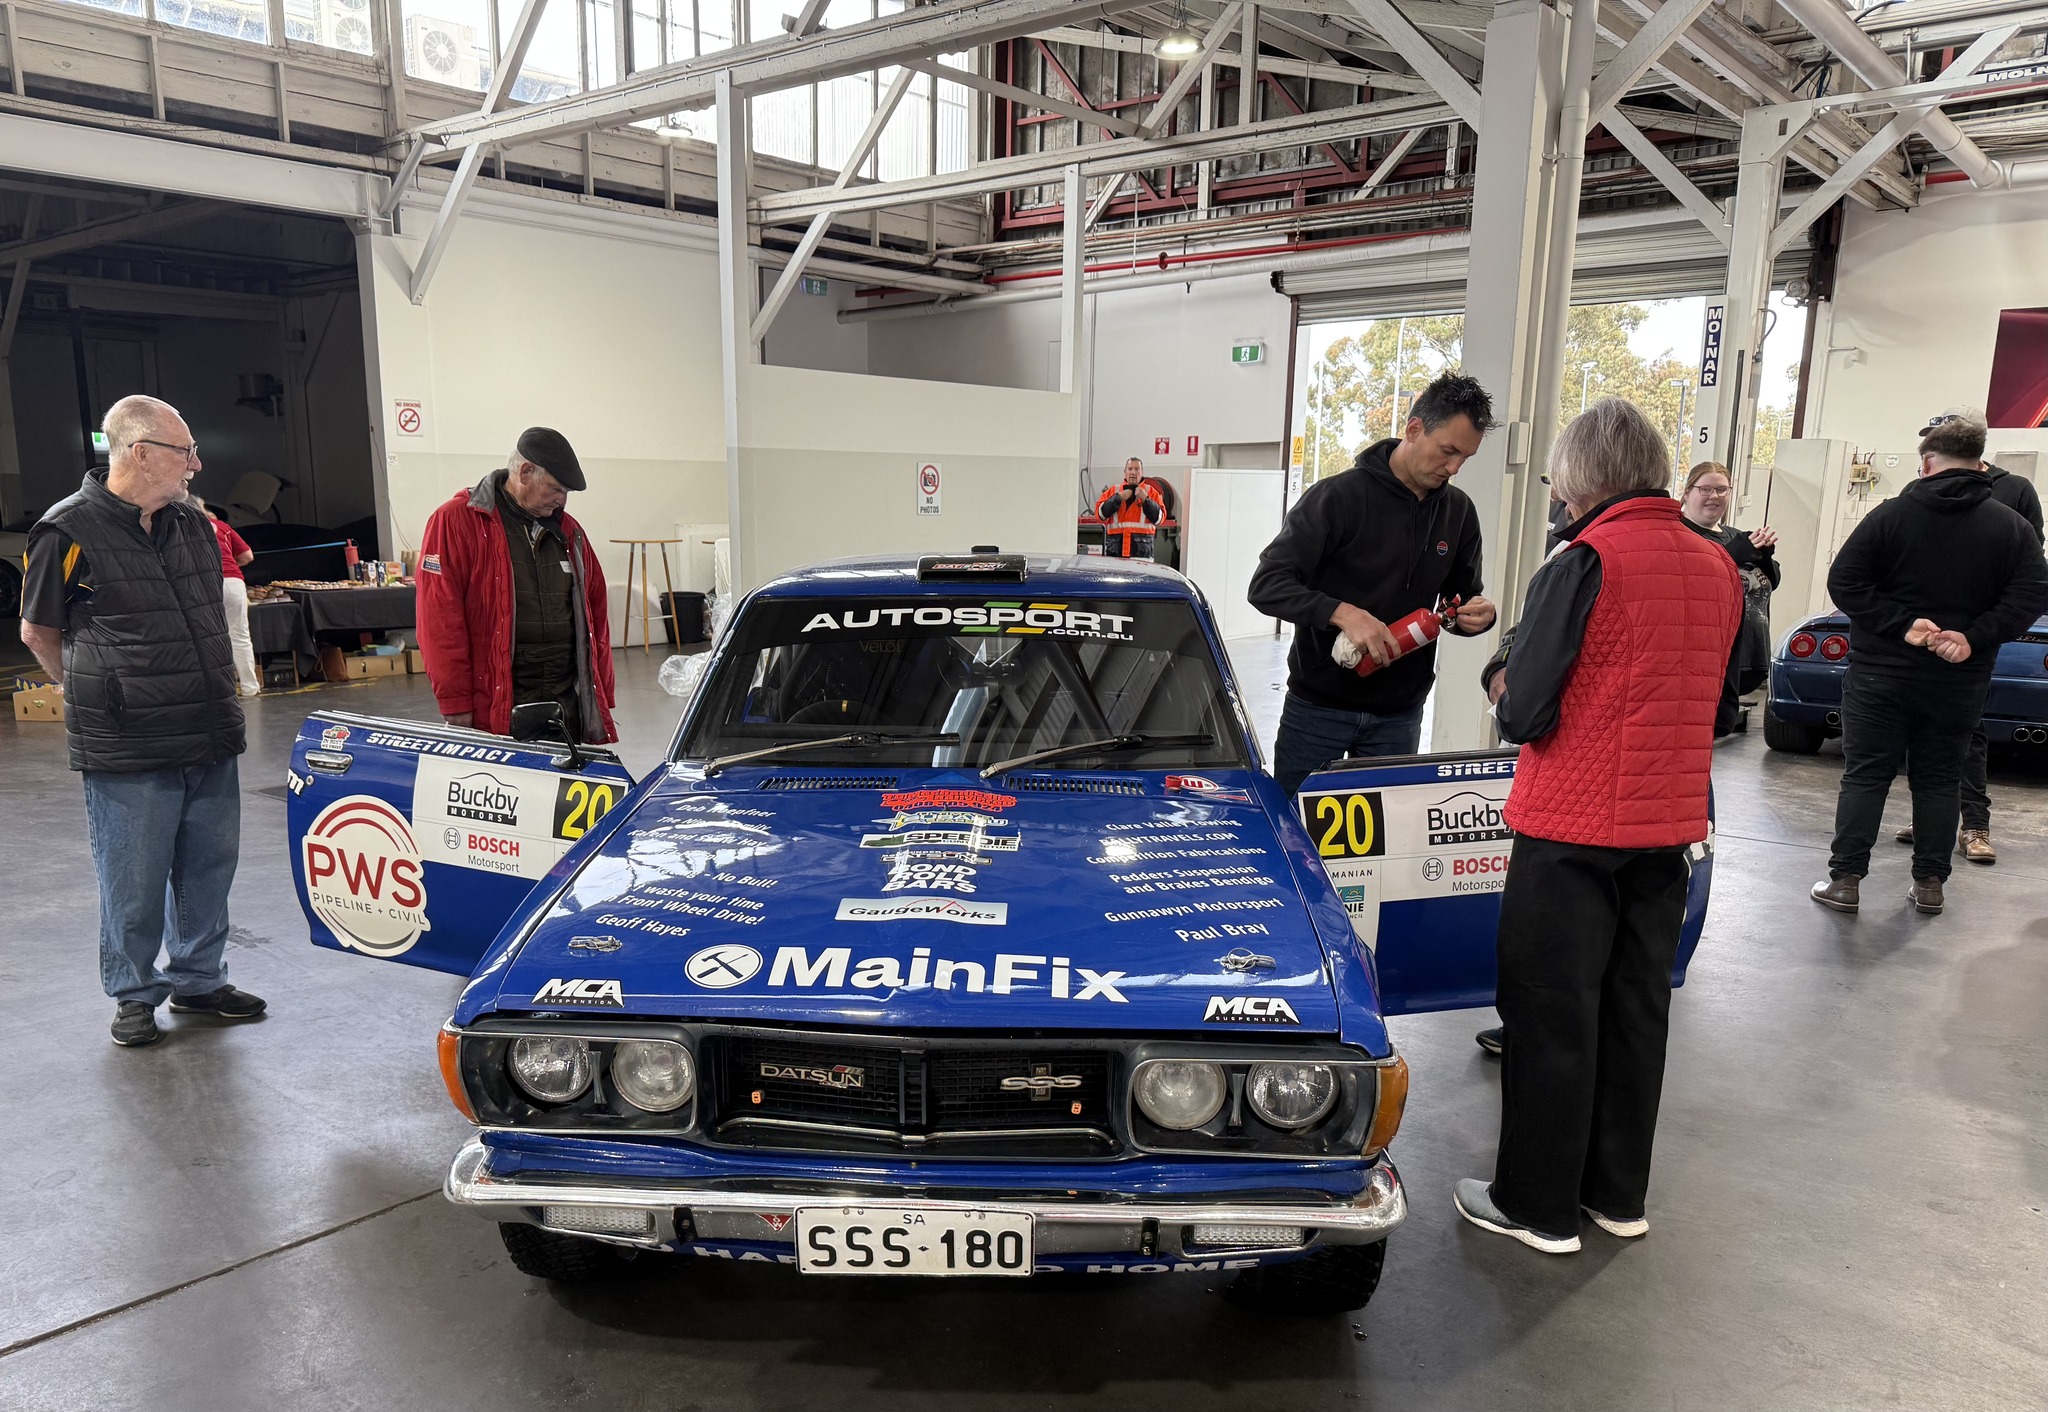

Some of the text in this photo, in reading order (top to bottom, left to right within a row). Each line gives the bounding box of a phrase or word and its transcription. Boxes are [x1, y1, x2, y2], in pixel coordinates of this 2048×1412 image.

[1703, 308, 1722, 384] MOLNAR
[1699, 427, 1708, 444] 5
[801, 607, 1133, 633] AUTOSPORT
[1047, 628, 1134, 641] .com.au
[447, 781, 519, 819] Buckby
[675, 804, 706, 812] Deb
[450, 807, 502, 822] MOTORS
[561, 781, 613, 839] 20
[657, 816, 682, 824] The
[1106, 822, 1143, 831] Clare
[1143, 820, 1189, 829] Valley
[1316, 794, 1374, 857] 20
[468, 834, 520, 857] BOSCH
[1434, 831, 1497, 844] MOTORS
[1176, 847, 1268, 859] Fabrications
[467, 854, 520, 872] Motorsport
[888, 864, 977, 876] BOND
[307, 842, 421, 908] PWS
[711, 873, 737, 882] No
[737, 876, 779, 888] Bull!
[890, 872, 970, 884] ROLL
[1109, 866, 1259, 883] Pedders Suspension
[881, 880, 977, 893] BARS
[1123, 876, 1275, 894] and Brakes Bendigo
[644, 885, 689, 899] waste
[691, 892, 728, 907] your
[727, 896, 765, 911] time
[313, 892, 372, 914] PIPELINE
[389, 908, 425, 925] CIVIL
[617, 895, 664, 908] Front
[663, 902, 715, 917] Wheel
[713, 909, 766, 926] Drive!
[849, 905, 997, 920] GaugeWorks
[1104, 897, 1286, 922] Gunnawyn Motorsport
[595, 913, 691, 937] Geoff Hayes
[1174, 922, 1270, 943] Paul Bray
[767, 946, 1130, 1004] MainFix
[531, 978, 623, 1004] MCA
[1202, 996, 1300, 1024] MCA
[1215, 1015, 1288, 1024] SUSPENSION
[761, 1065, 864, 1087] DATSUN
[902, 1214, 926, 1226] SA
